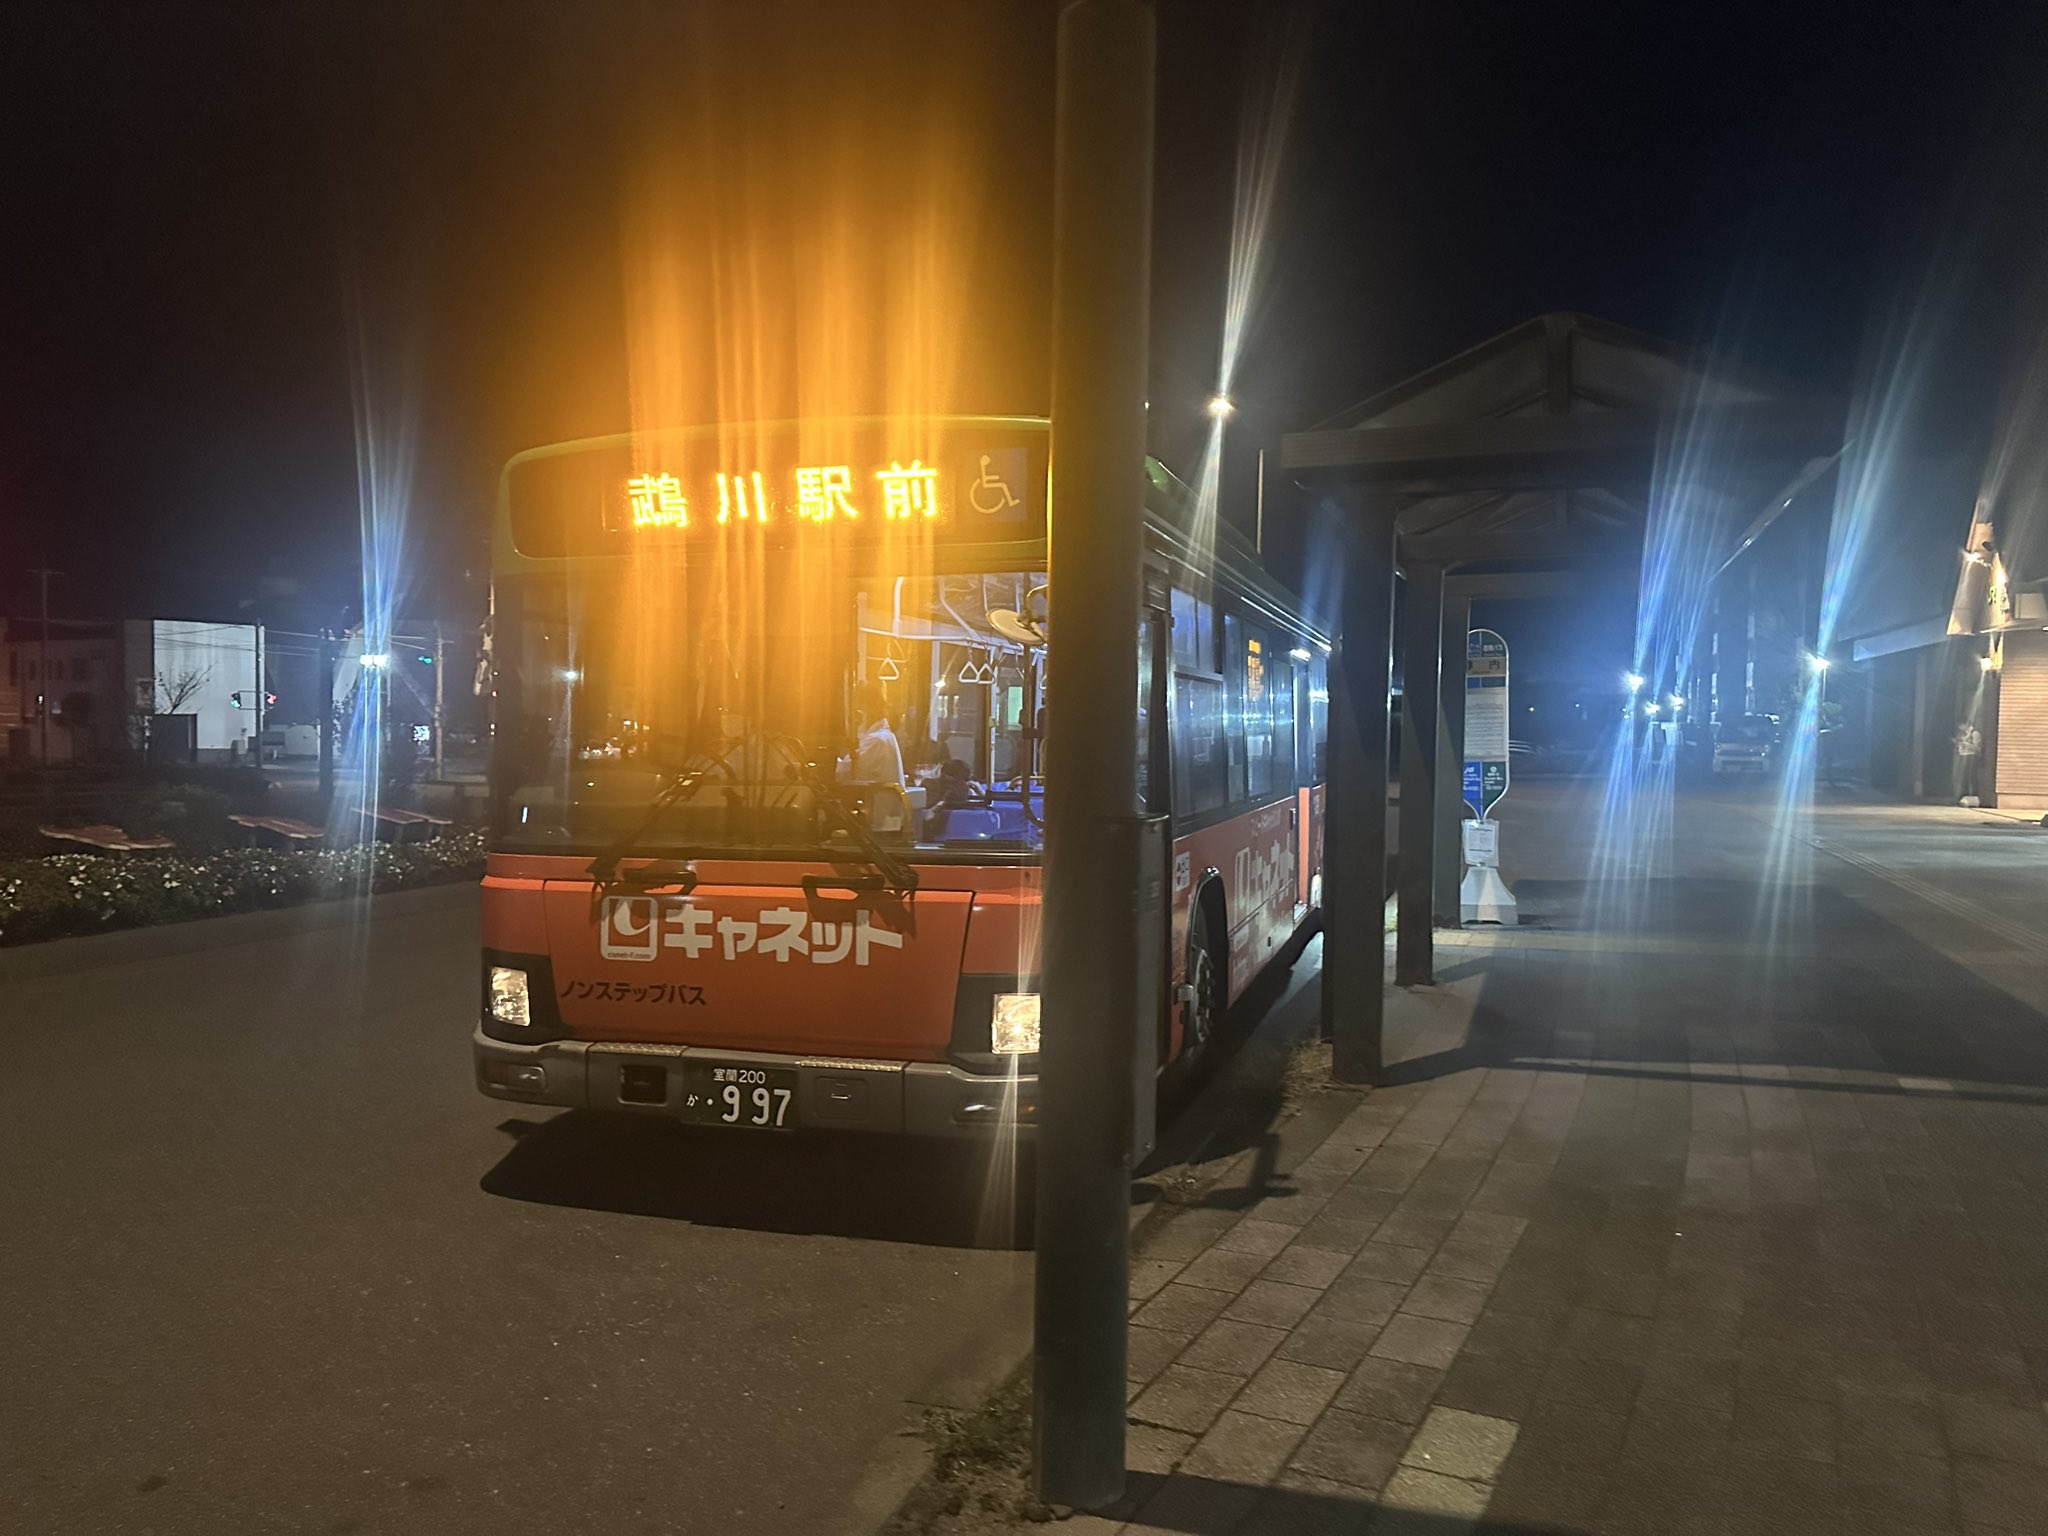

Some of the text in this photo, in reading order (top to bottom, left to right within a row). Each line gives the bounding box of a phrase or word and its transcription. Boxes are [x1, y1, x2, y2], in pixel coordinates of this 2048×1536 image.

[627, 459, 940, 529] 鵡川駅前
[664, 904, 903, 966] キャネット
[560, 980, 707, 1006] ノンステップバス
